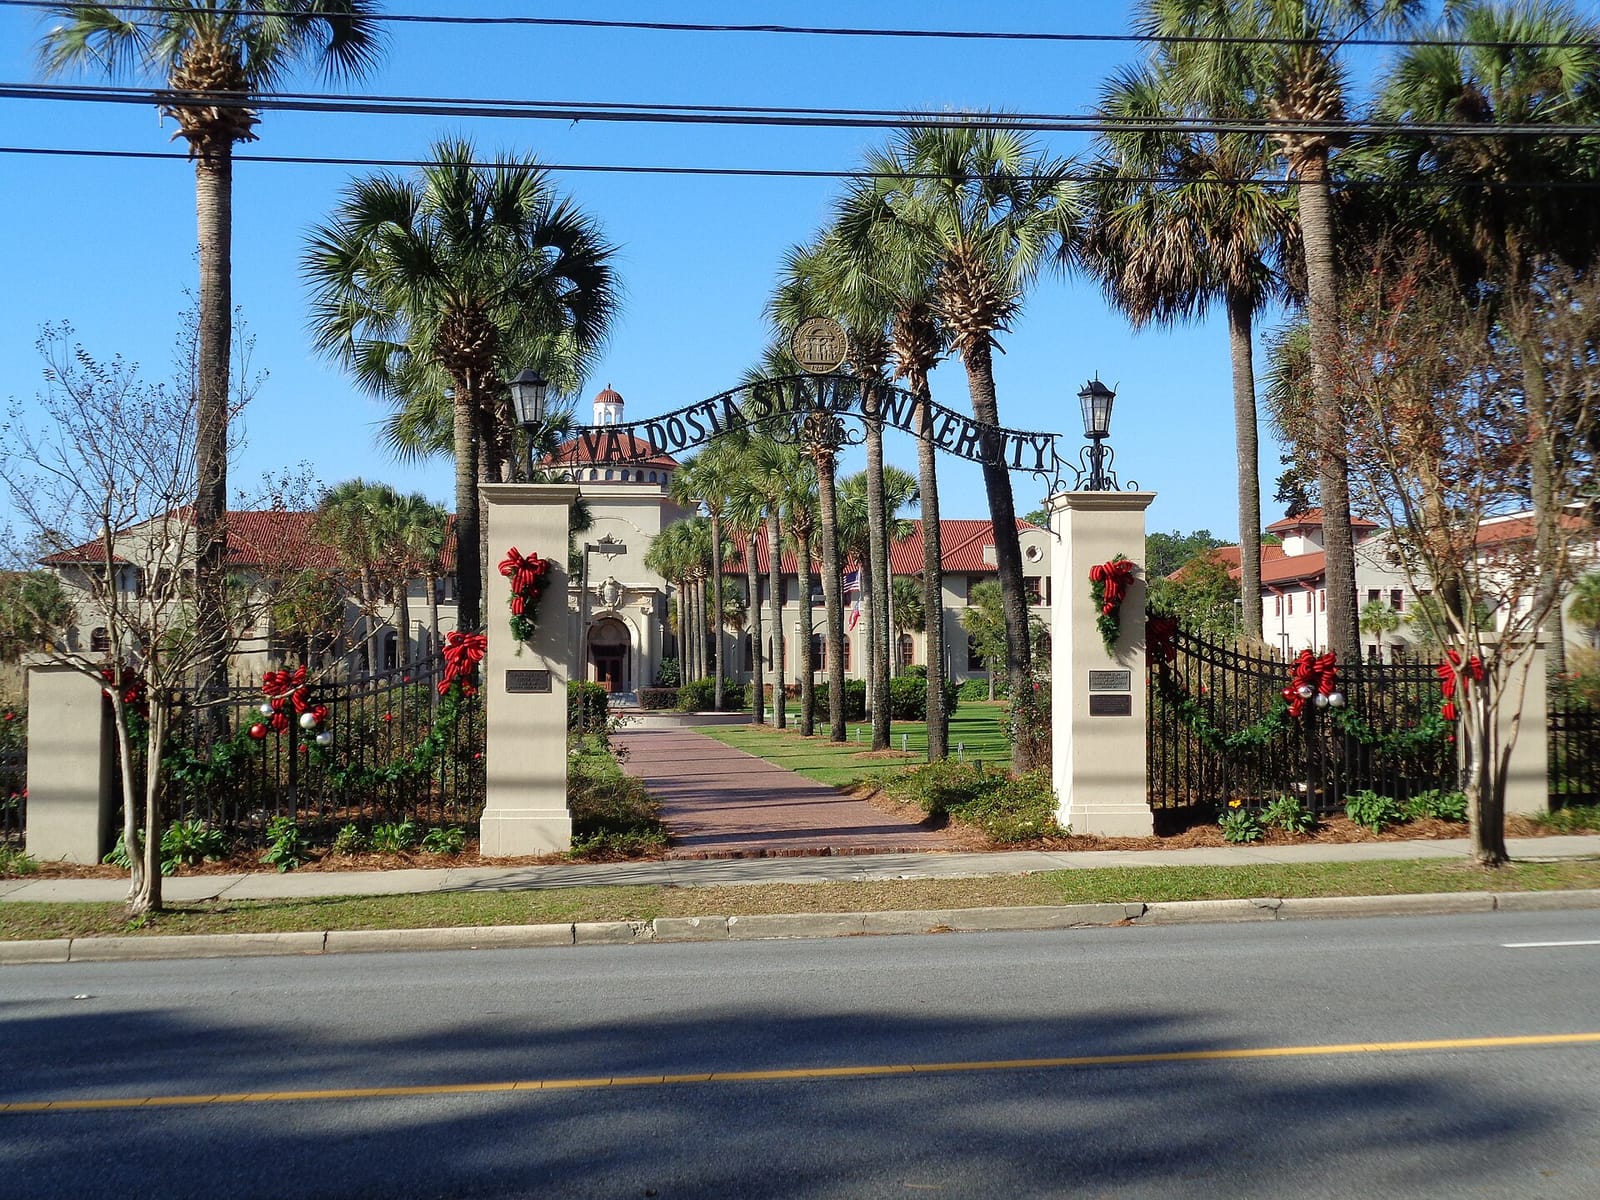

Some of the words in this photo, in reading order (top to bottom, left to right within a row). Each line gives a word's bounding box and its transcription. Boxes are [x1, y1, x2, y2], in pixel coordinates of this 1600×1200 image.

[580, 395, 748, 463] VALDOSTA
[753, 376, 850, 418] STATE
[860, 380, 1051, 469] UNIVERITY
